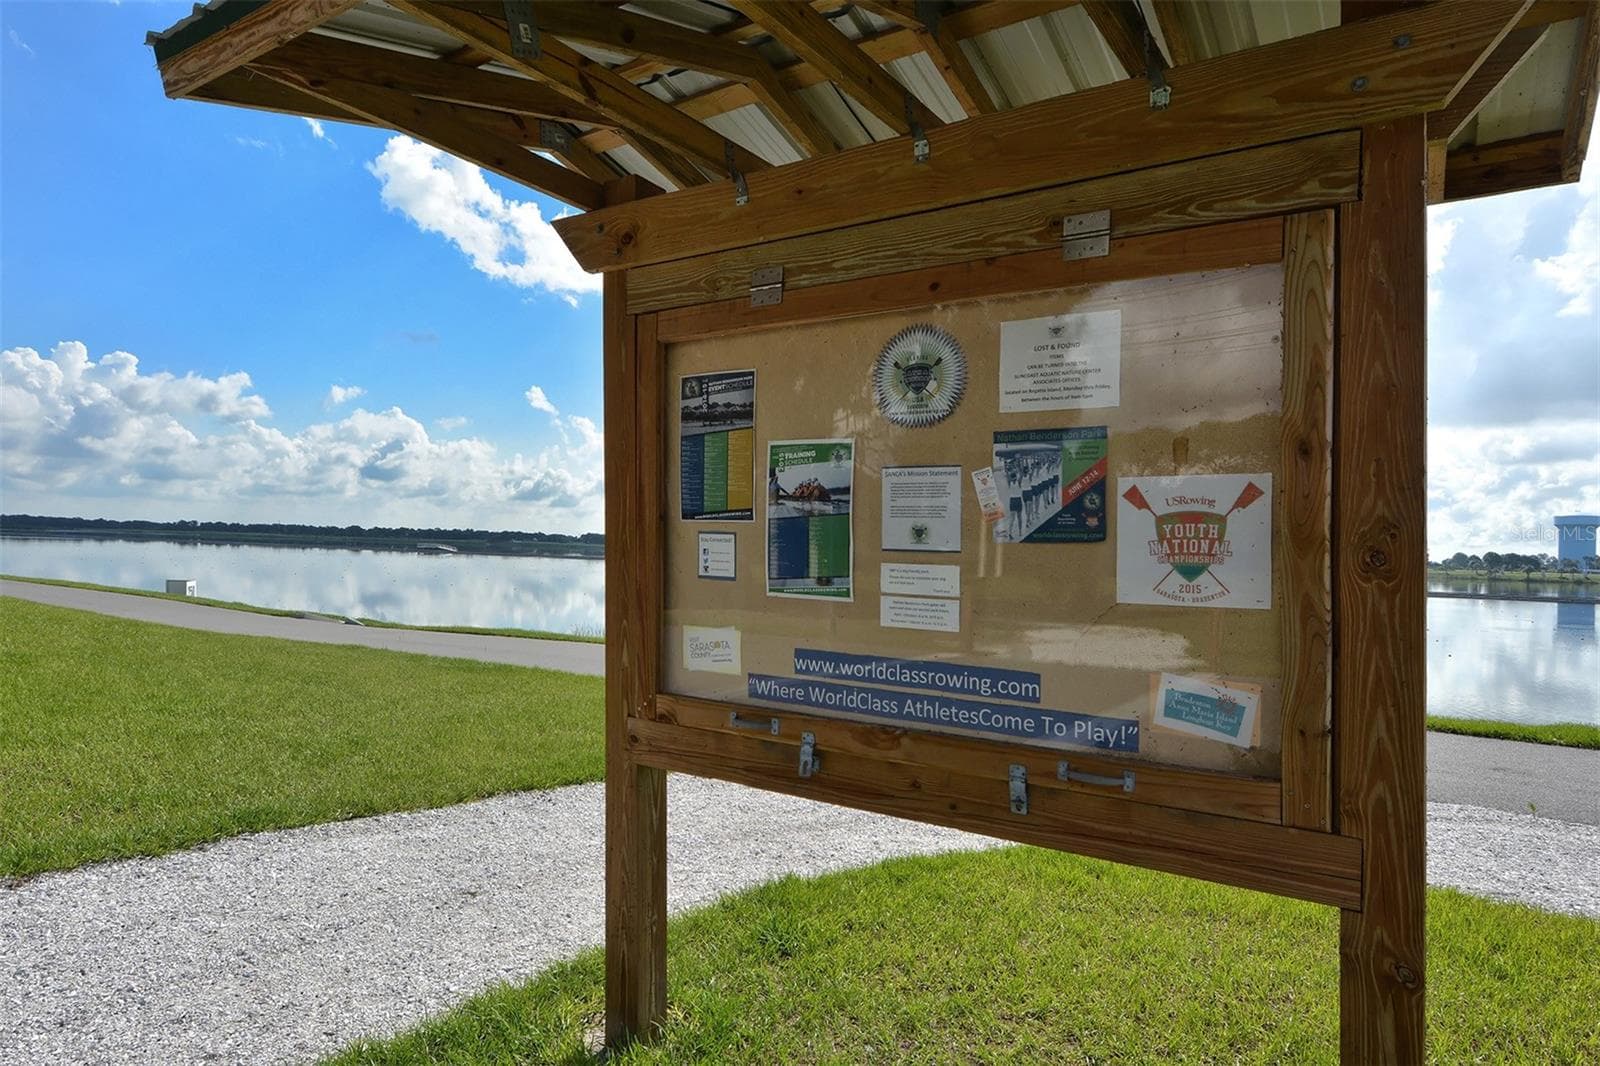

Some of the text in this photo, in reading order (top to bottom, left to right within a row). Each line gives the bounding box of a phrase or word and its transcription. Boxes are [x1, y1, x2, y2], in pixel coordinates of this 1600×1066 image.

[997, 429, 1105, 442] Nathan Benderson Park
[785, 450, 816, 460] TRAINING
[785, 458, 814, 466] SCHEDULE
[1069, 482, 1082, 494] JUNE
[1165, 496, 1216, 509] USRowing
[1162, 524, 1220, 538] YOUTH
[1148, 538, 1232, 556] NATIONAL
[1158, 554, 1225, 565] CHAMPIONSHIPS
[1156, 588, 1226, 602] SARASOTA BRADENTON
[1178, 584, 1202, 594] 2015
[690, 650, 711, 658] COUNTY
[794, 657, 1040, 698] www.worldclassrowing.com
[1174, 693, 1211, 709] Bradenton
[749, 677, 804, 700] “Where
[809, 686, 898, 714] WorldClass
[1041, 716, 1066, 736] To
[1074, 720, 1138, 748] Play!”
[1169, 700, 1238, 724] Anna Maria Island
[1182, 712, 1234, 731] Longboat Key
